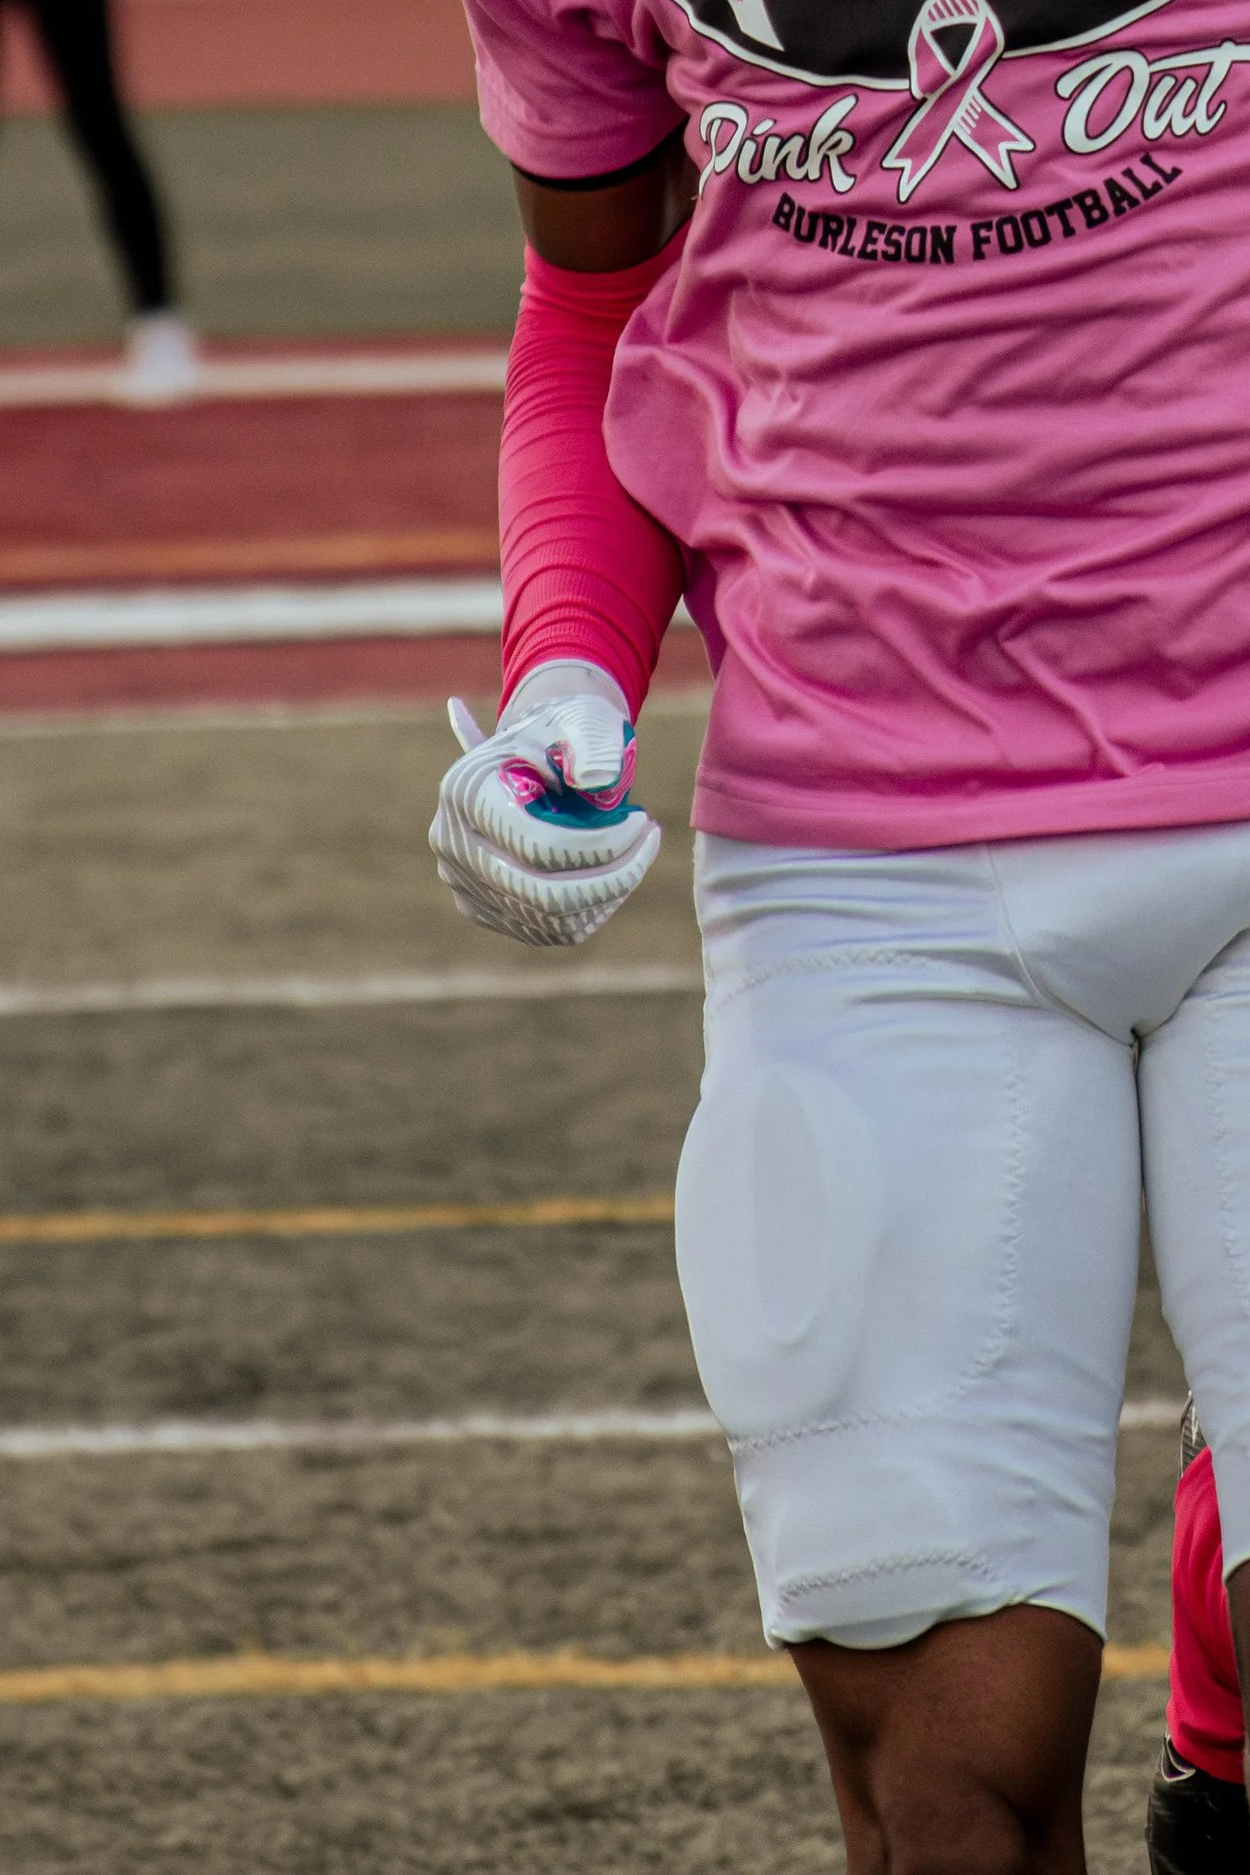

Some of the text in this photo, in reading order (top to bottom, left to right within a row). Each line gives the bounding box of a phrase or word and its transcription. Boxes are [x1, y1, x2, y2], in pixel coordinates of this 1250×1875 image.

[700, 95, 860, 198] Pink
[771, 151, 1184, 264] BURLESON FOOTBALL
